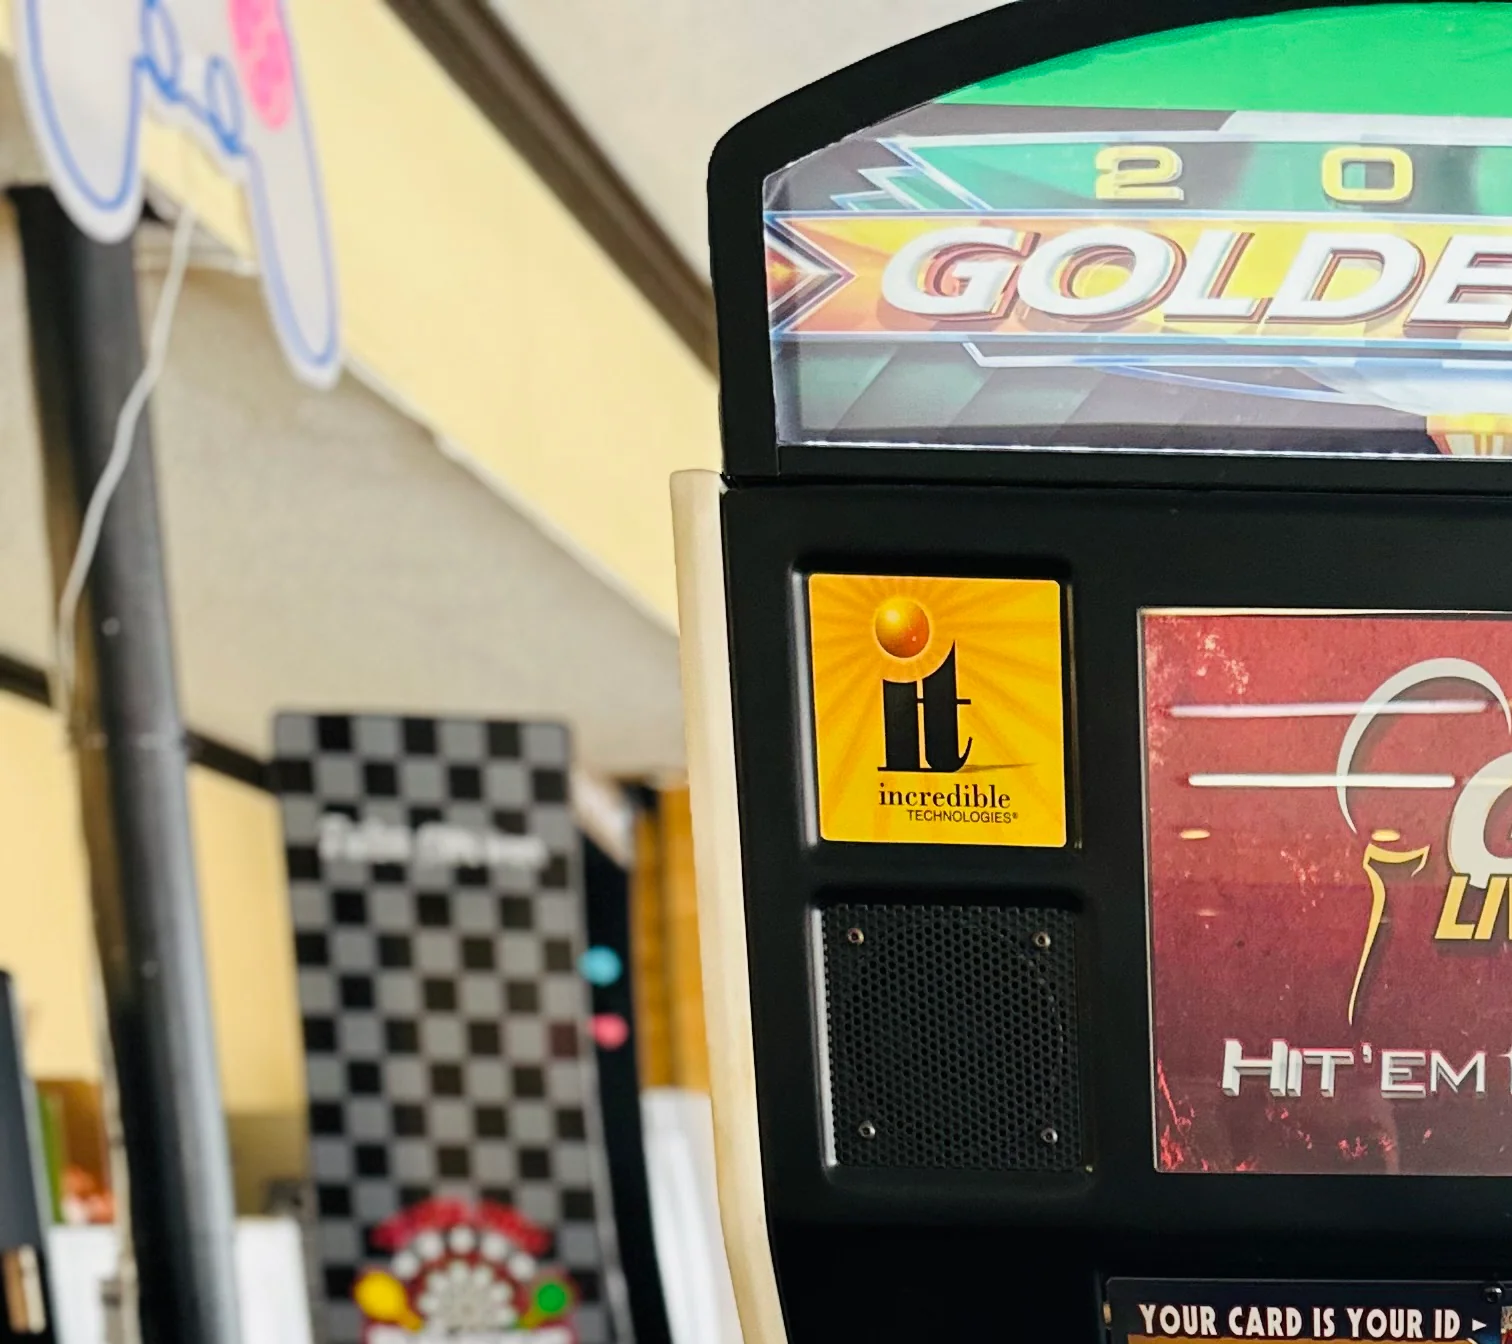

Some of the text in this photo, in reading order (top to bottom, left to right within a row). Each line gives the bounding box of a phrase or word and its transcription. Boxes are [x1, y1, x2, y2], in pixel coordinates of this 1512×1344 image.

[878, 783, 1011, 808] incredible
[1138, 1304, 1461, 1339] YOUR CARD IS YOUR ID
